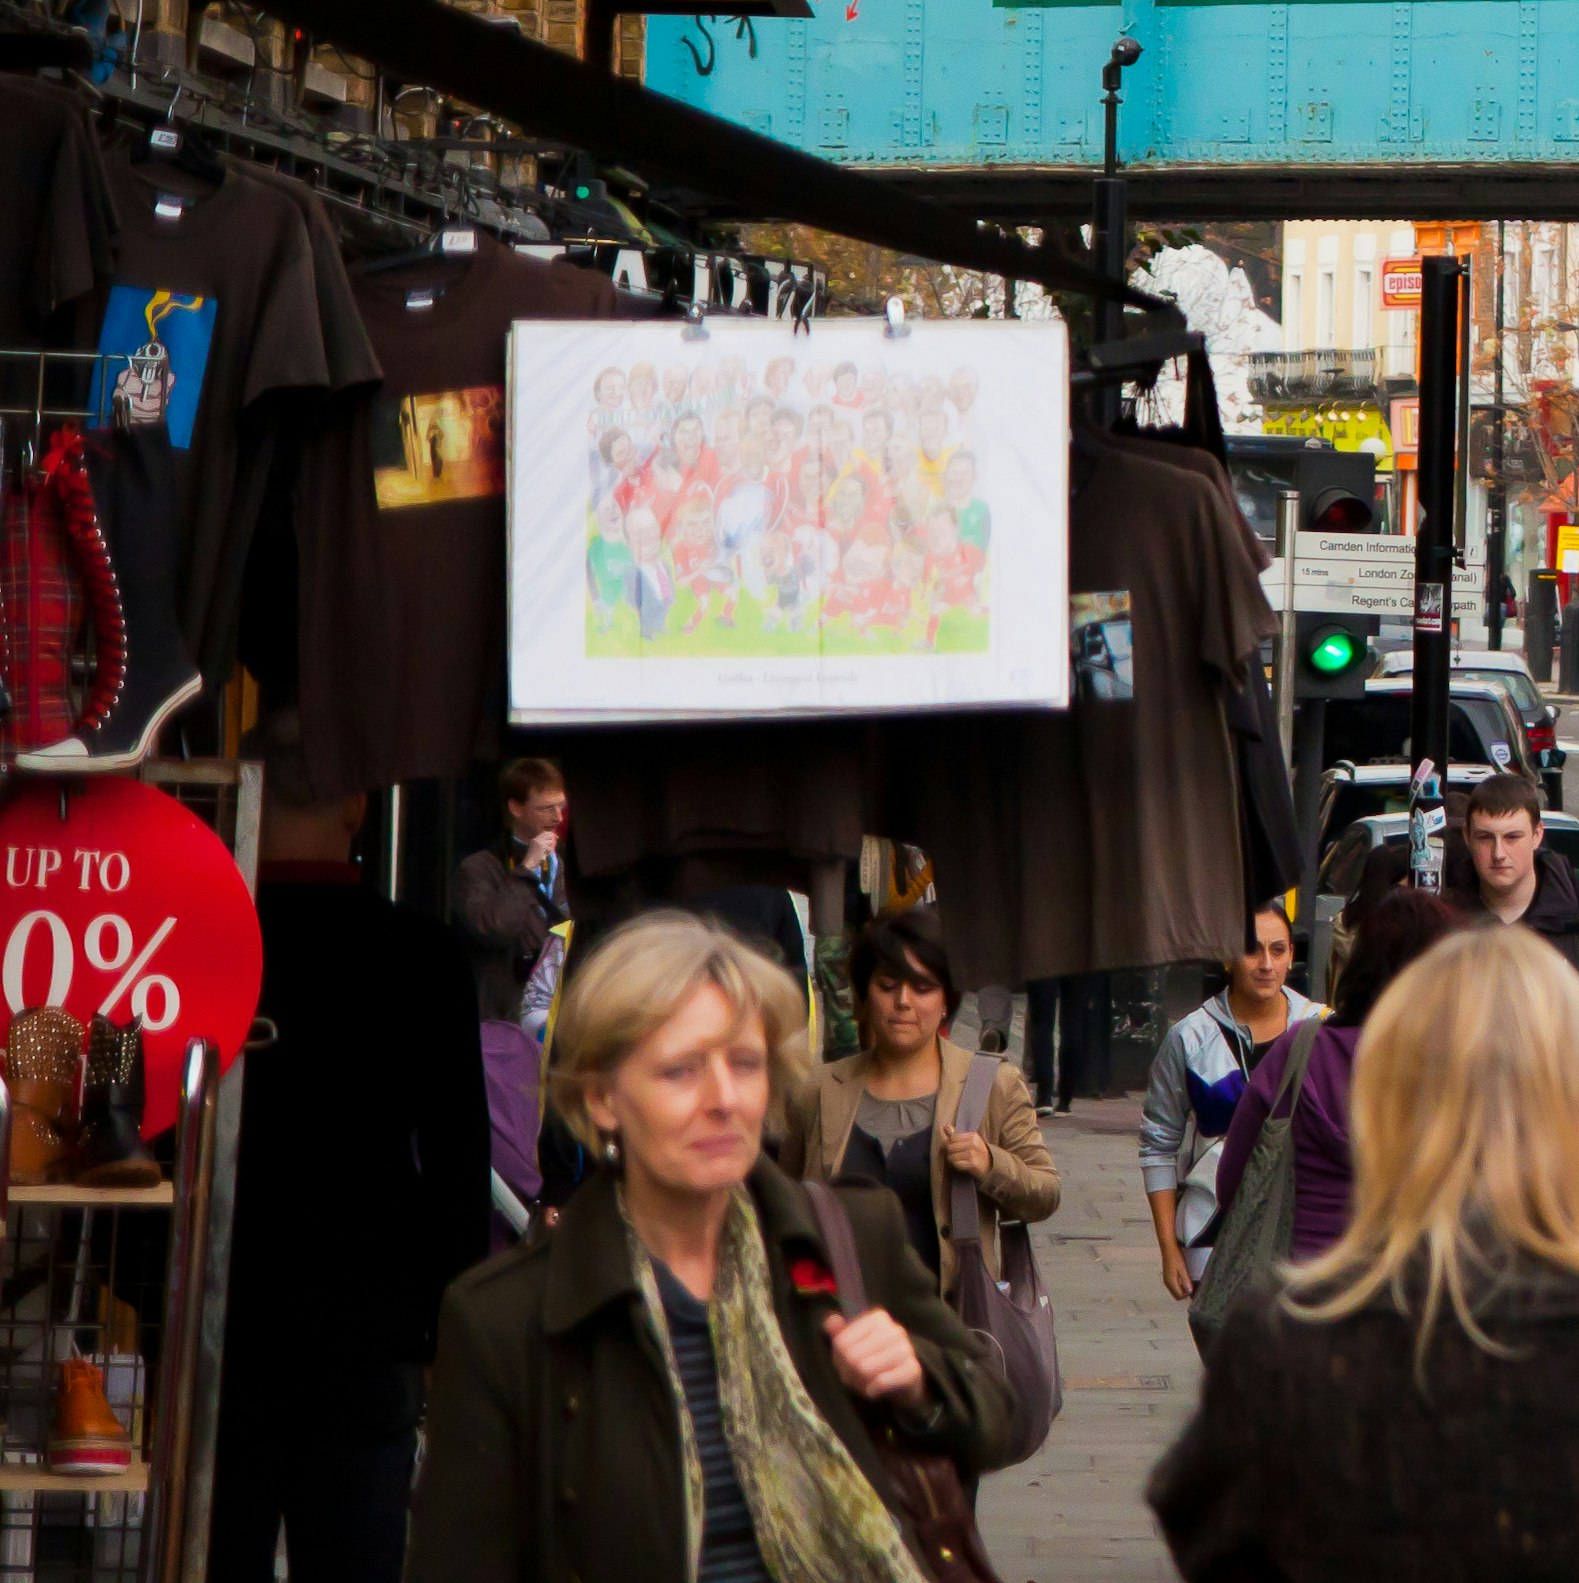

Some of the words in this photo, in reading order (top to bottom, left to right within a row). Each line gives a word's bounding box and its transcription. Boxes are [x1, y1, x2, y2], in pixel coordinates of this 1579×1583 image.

[1319, 540, 1363, 552] Camden
[1301, 568, 1310, 576] 15
[1358, 568, 1397, 580] London
[1352, 595, 1397, 609] Regent's
[5, 846, 61, 891] UP
[73, 847, 130, 893] TO
